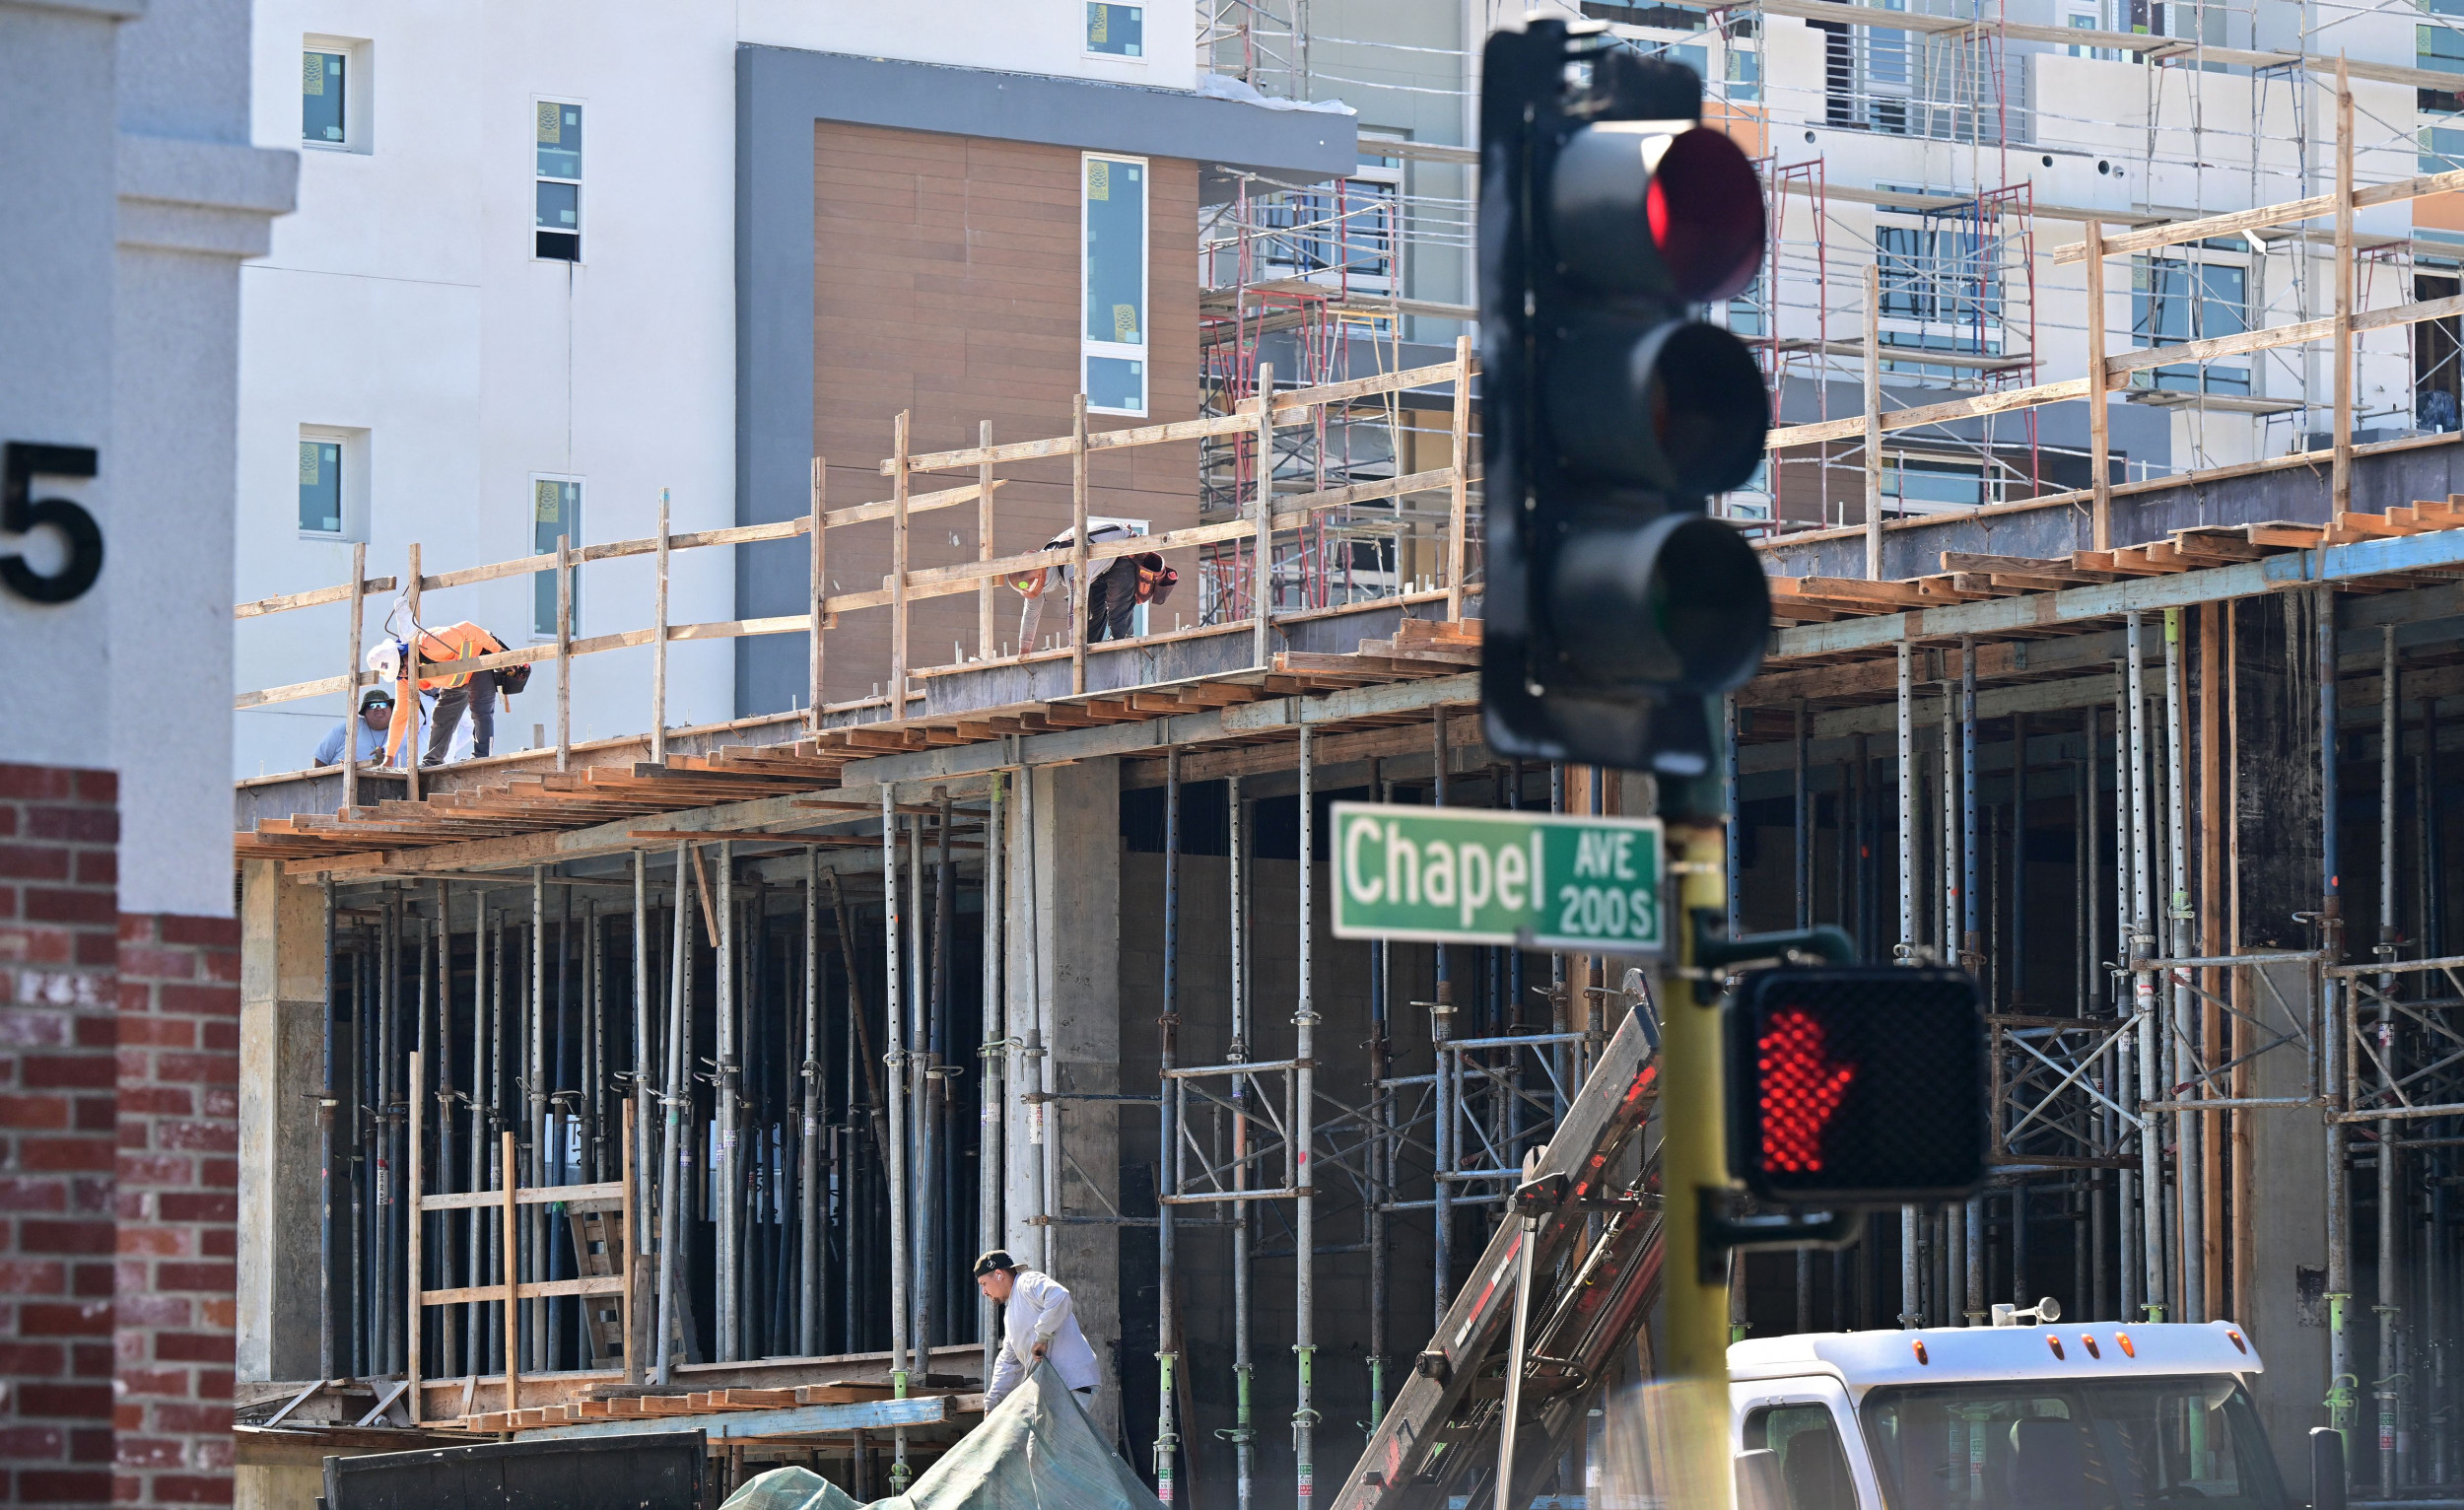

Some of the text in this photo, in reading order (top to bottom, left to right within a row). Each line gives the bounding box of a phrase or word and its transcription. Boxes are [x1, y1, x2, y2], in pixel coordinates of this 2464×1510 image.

[0, 441, 103, 607] 5
[1344, 816, 1544, 928] Chapel
[1574, 830, 1637, 880] AVE
